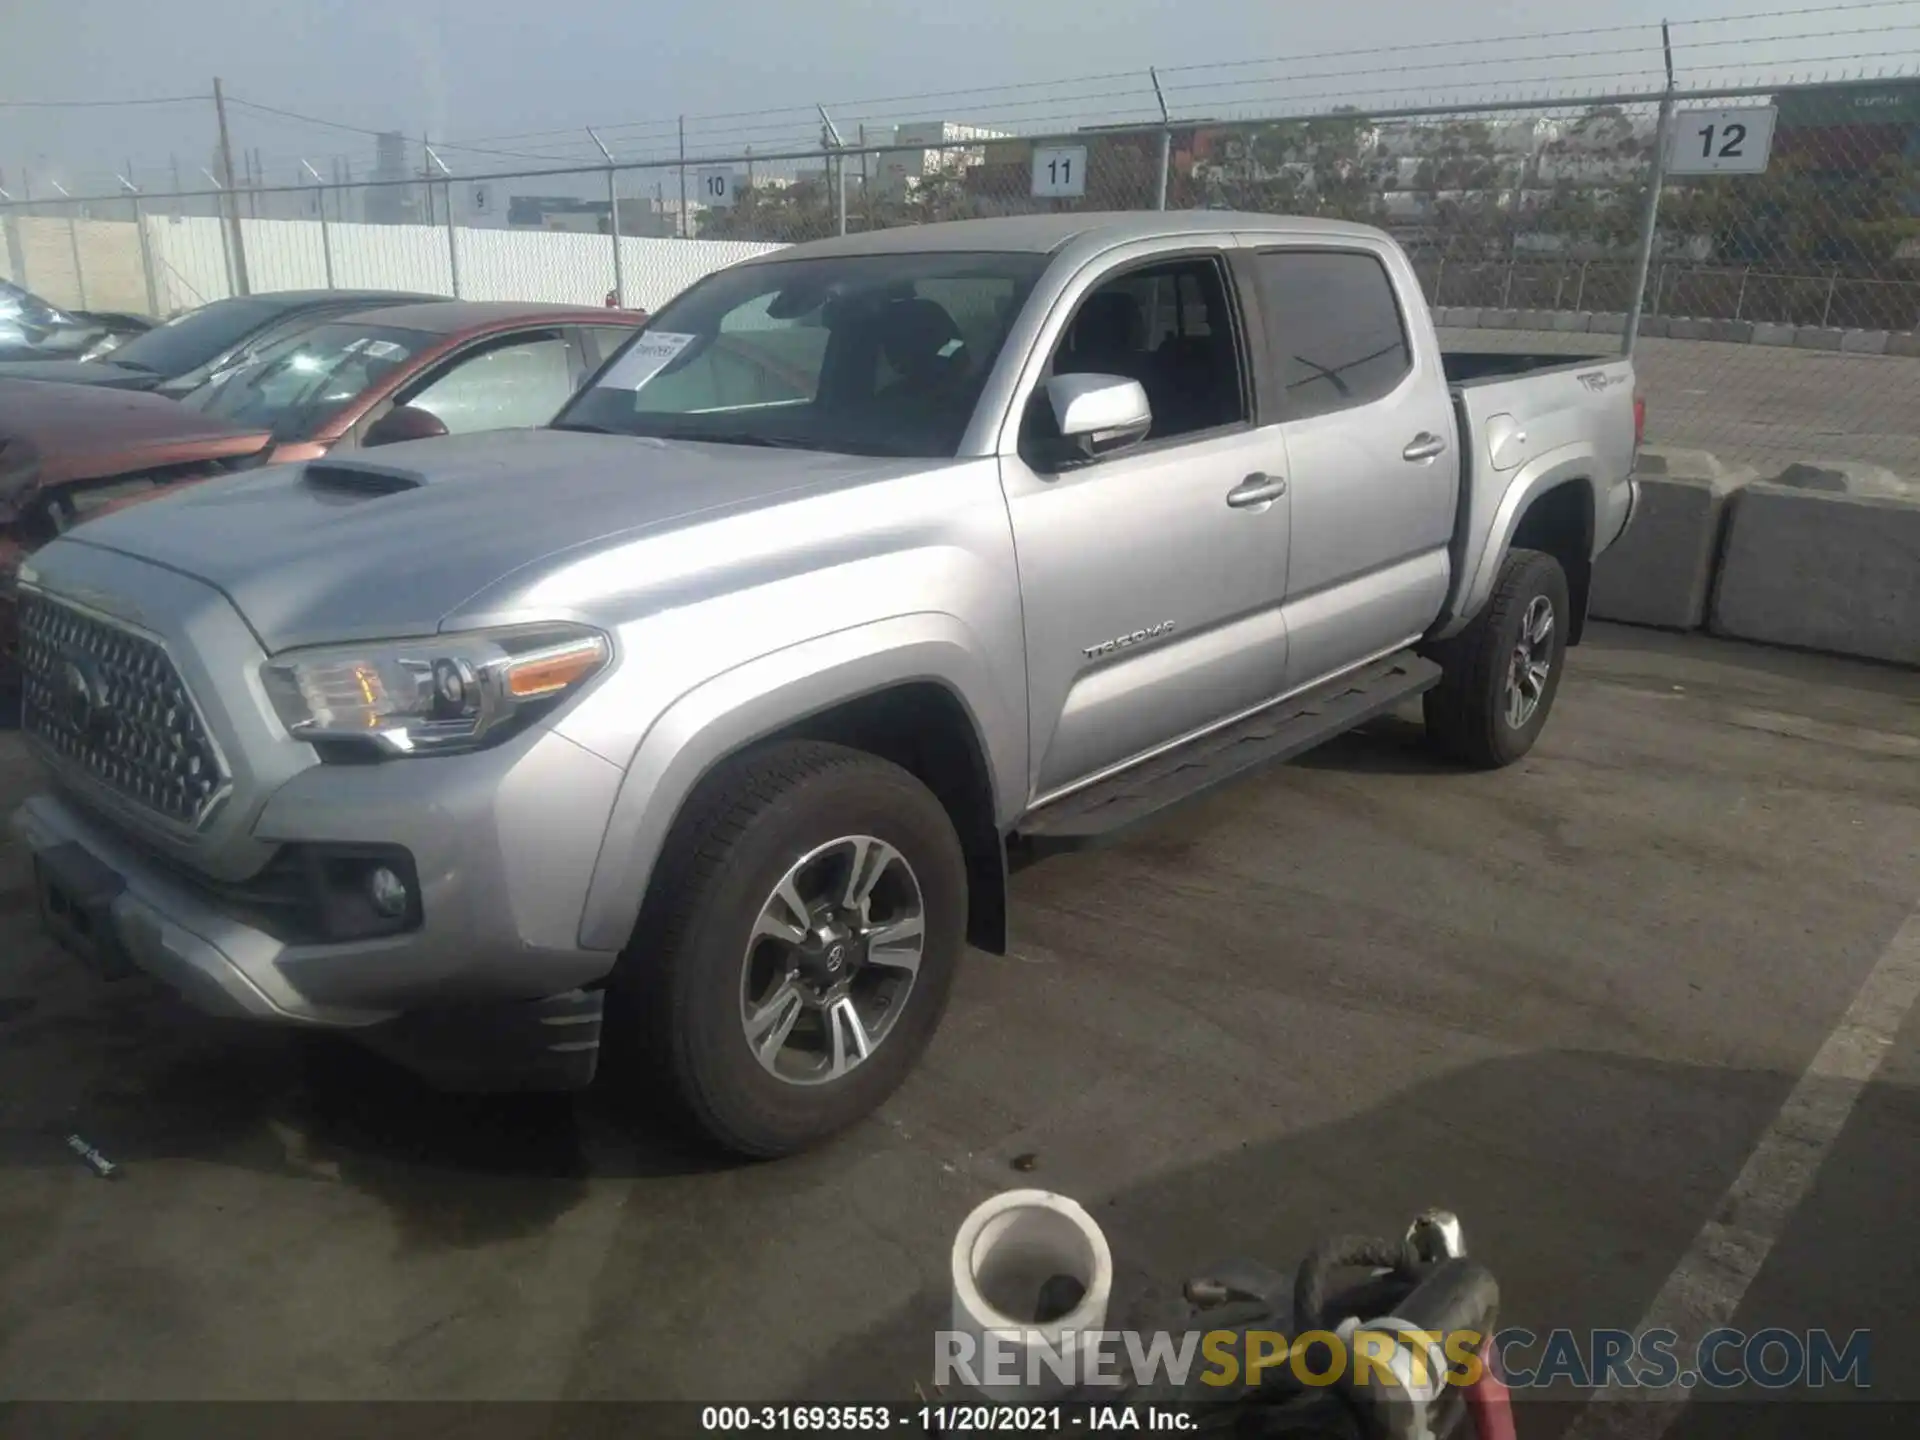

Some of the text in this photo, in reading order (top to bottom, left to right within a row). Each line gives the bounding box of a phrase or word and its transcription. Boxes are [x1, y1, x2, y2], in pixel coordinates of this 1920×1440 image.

[1698, 123, 1747, 158] 12
[1047, 157, 1071, 185] 11
[476, 191, 484, 208] 9
[706, 176, 725, 197] 10
[1081, 619, 1176, 659] TACOMA
